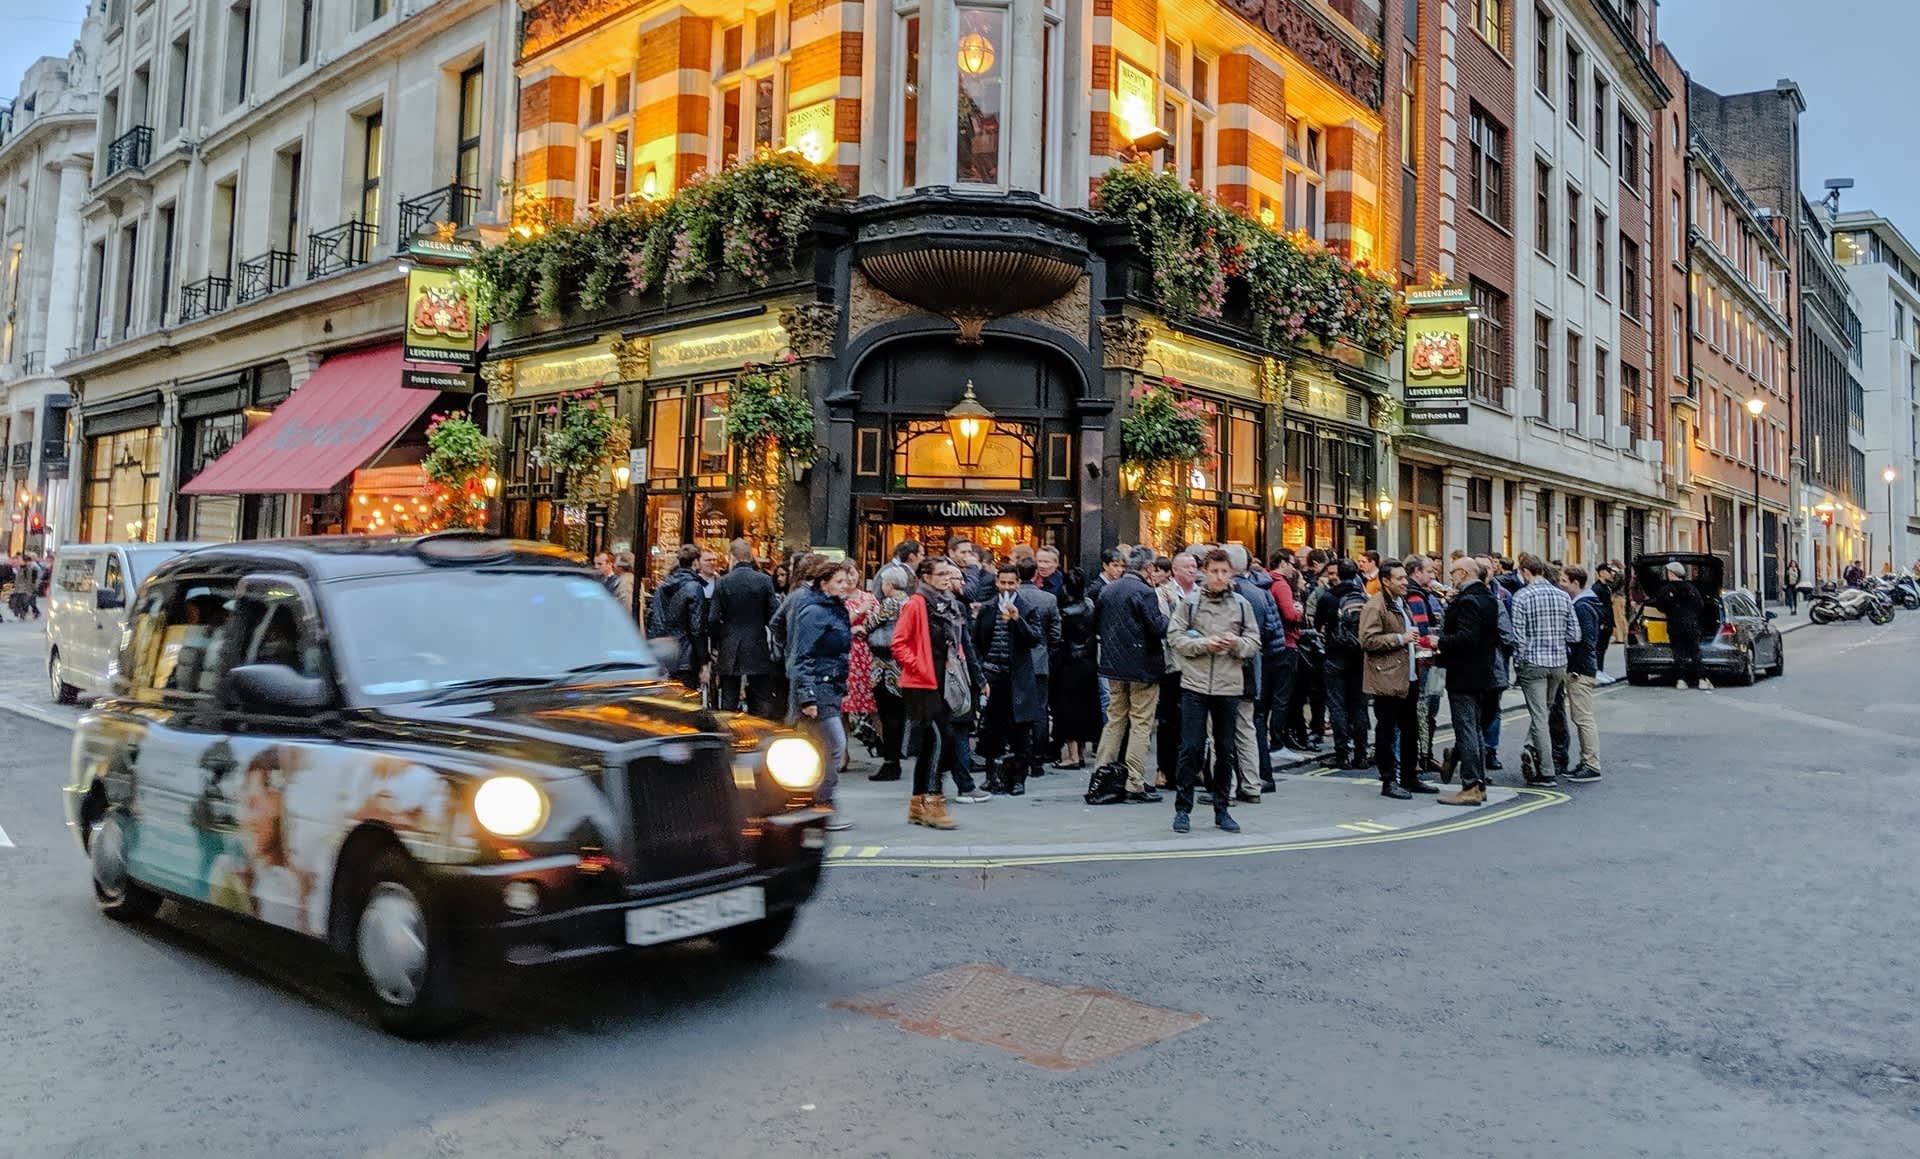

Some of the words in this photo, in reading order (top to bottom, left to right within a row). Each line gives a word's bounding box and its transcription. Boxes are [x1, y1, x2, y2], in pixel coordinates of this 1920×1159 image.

[418, 239, 451, 251] GREENE
[1412, 290, 1441, 298] GREENE
[1443, 288, 1463, 297] KING
[409, 348, 449, 359] LEICESTER
[448, 351, 470, 361] ARMS
[1409, 387, 1443, 396] LEICESTER
[1443, 387, 1463, 395] ARMS
[940, 501, 1006, 516] GUINNESS
